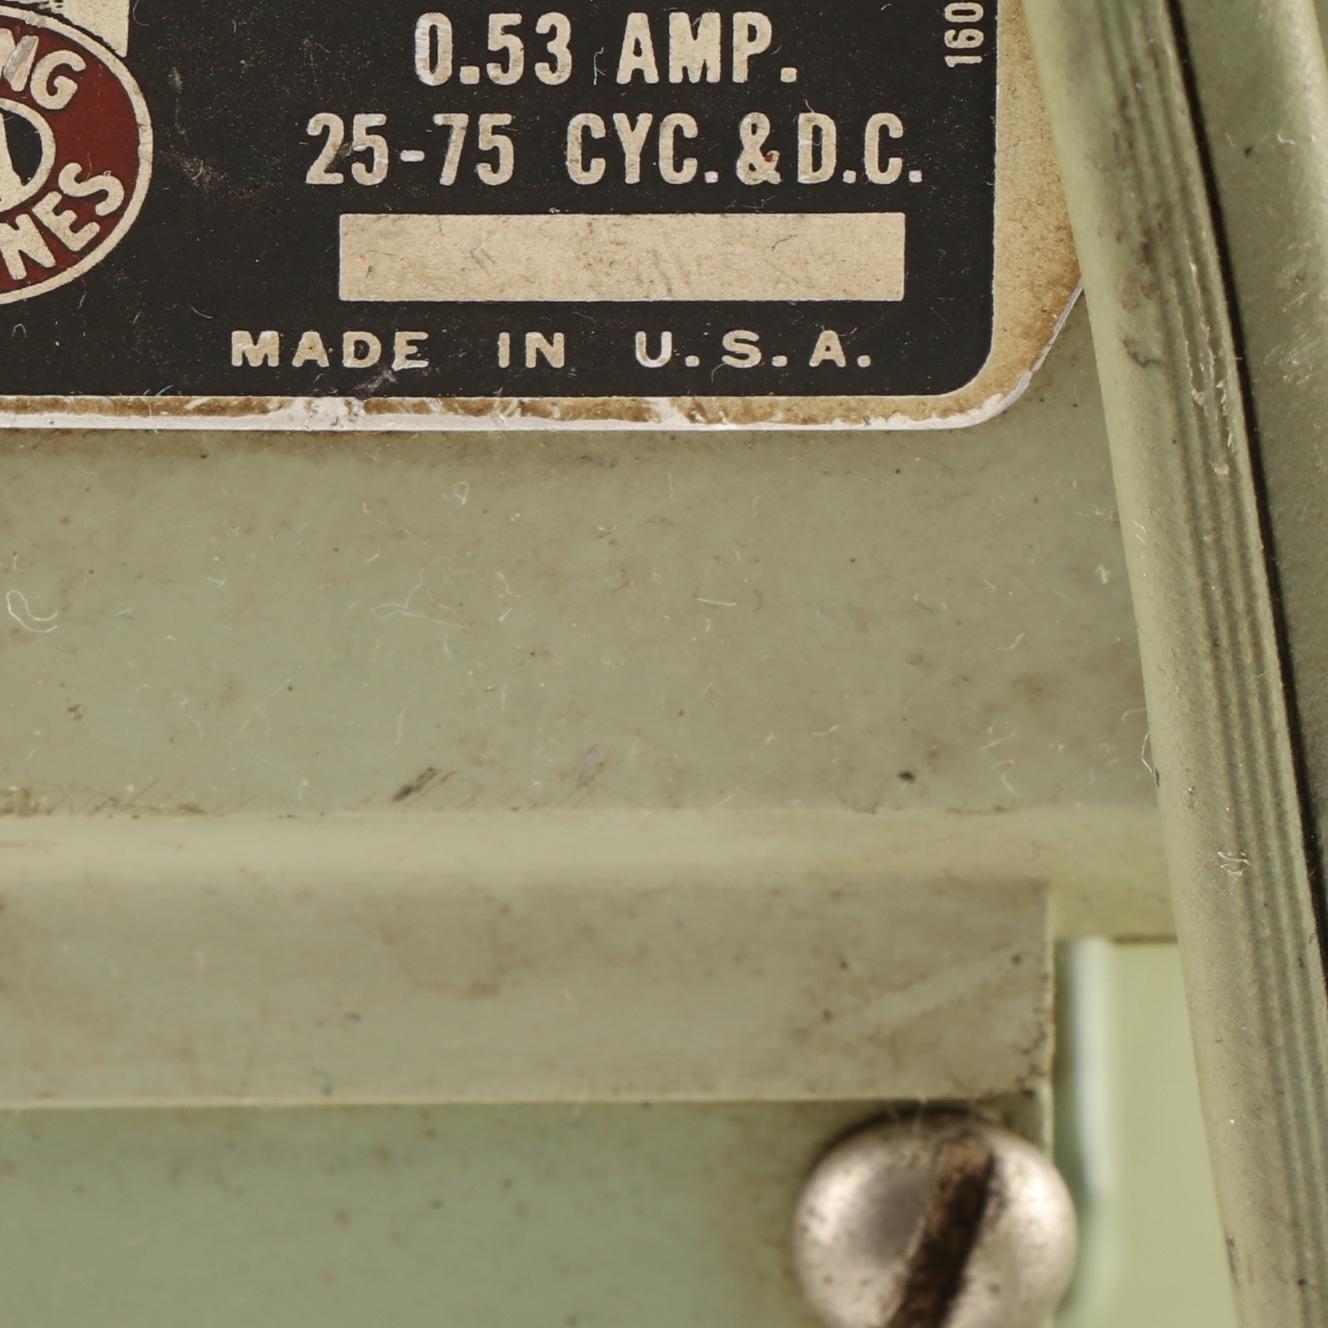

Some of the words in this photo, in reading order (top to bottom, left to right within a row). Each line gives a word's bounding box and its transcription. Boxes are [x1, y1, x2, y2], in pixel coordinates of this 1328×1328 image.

[414, 12, 573, 87] 0.53
[616, 12, 799, 85] AMP.
[304, 112, 516, 186] 25-75
[230, 329, 430, 372] MADE
[496, 330, 566, 370] IN
[633, 328, 872, 370] U.S.A.
